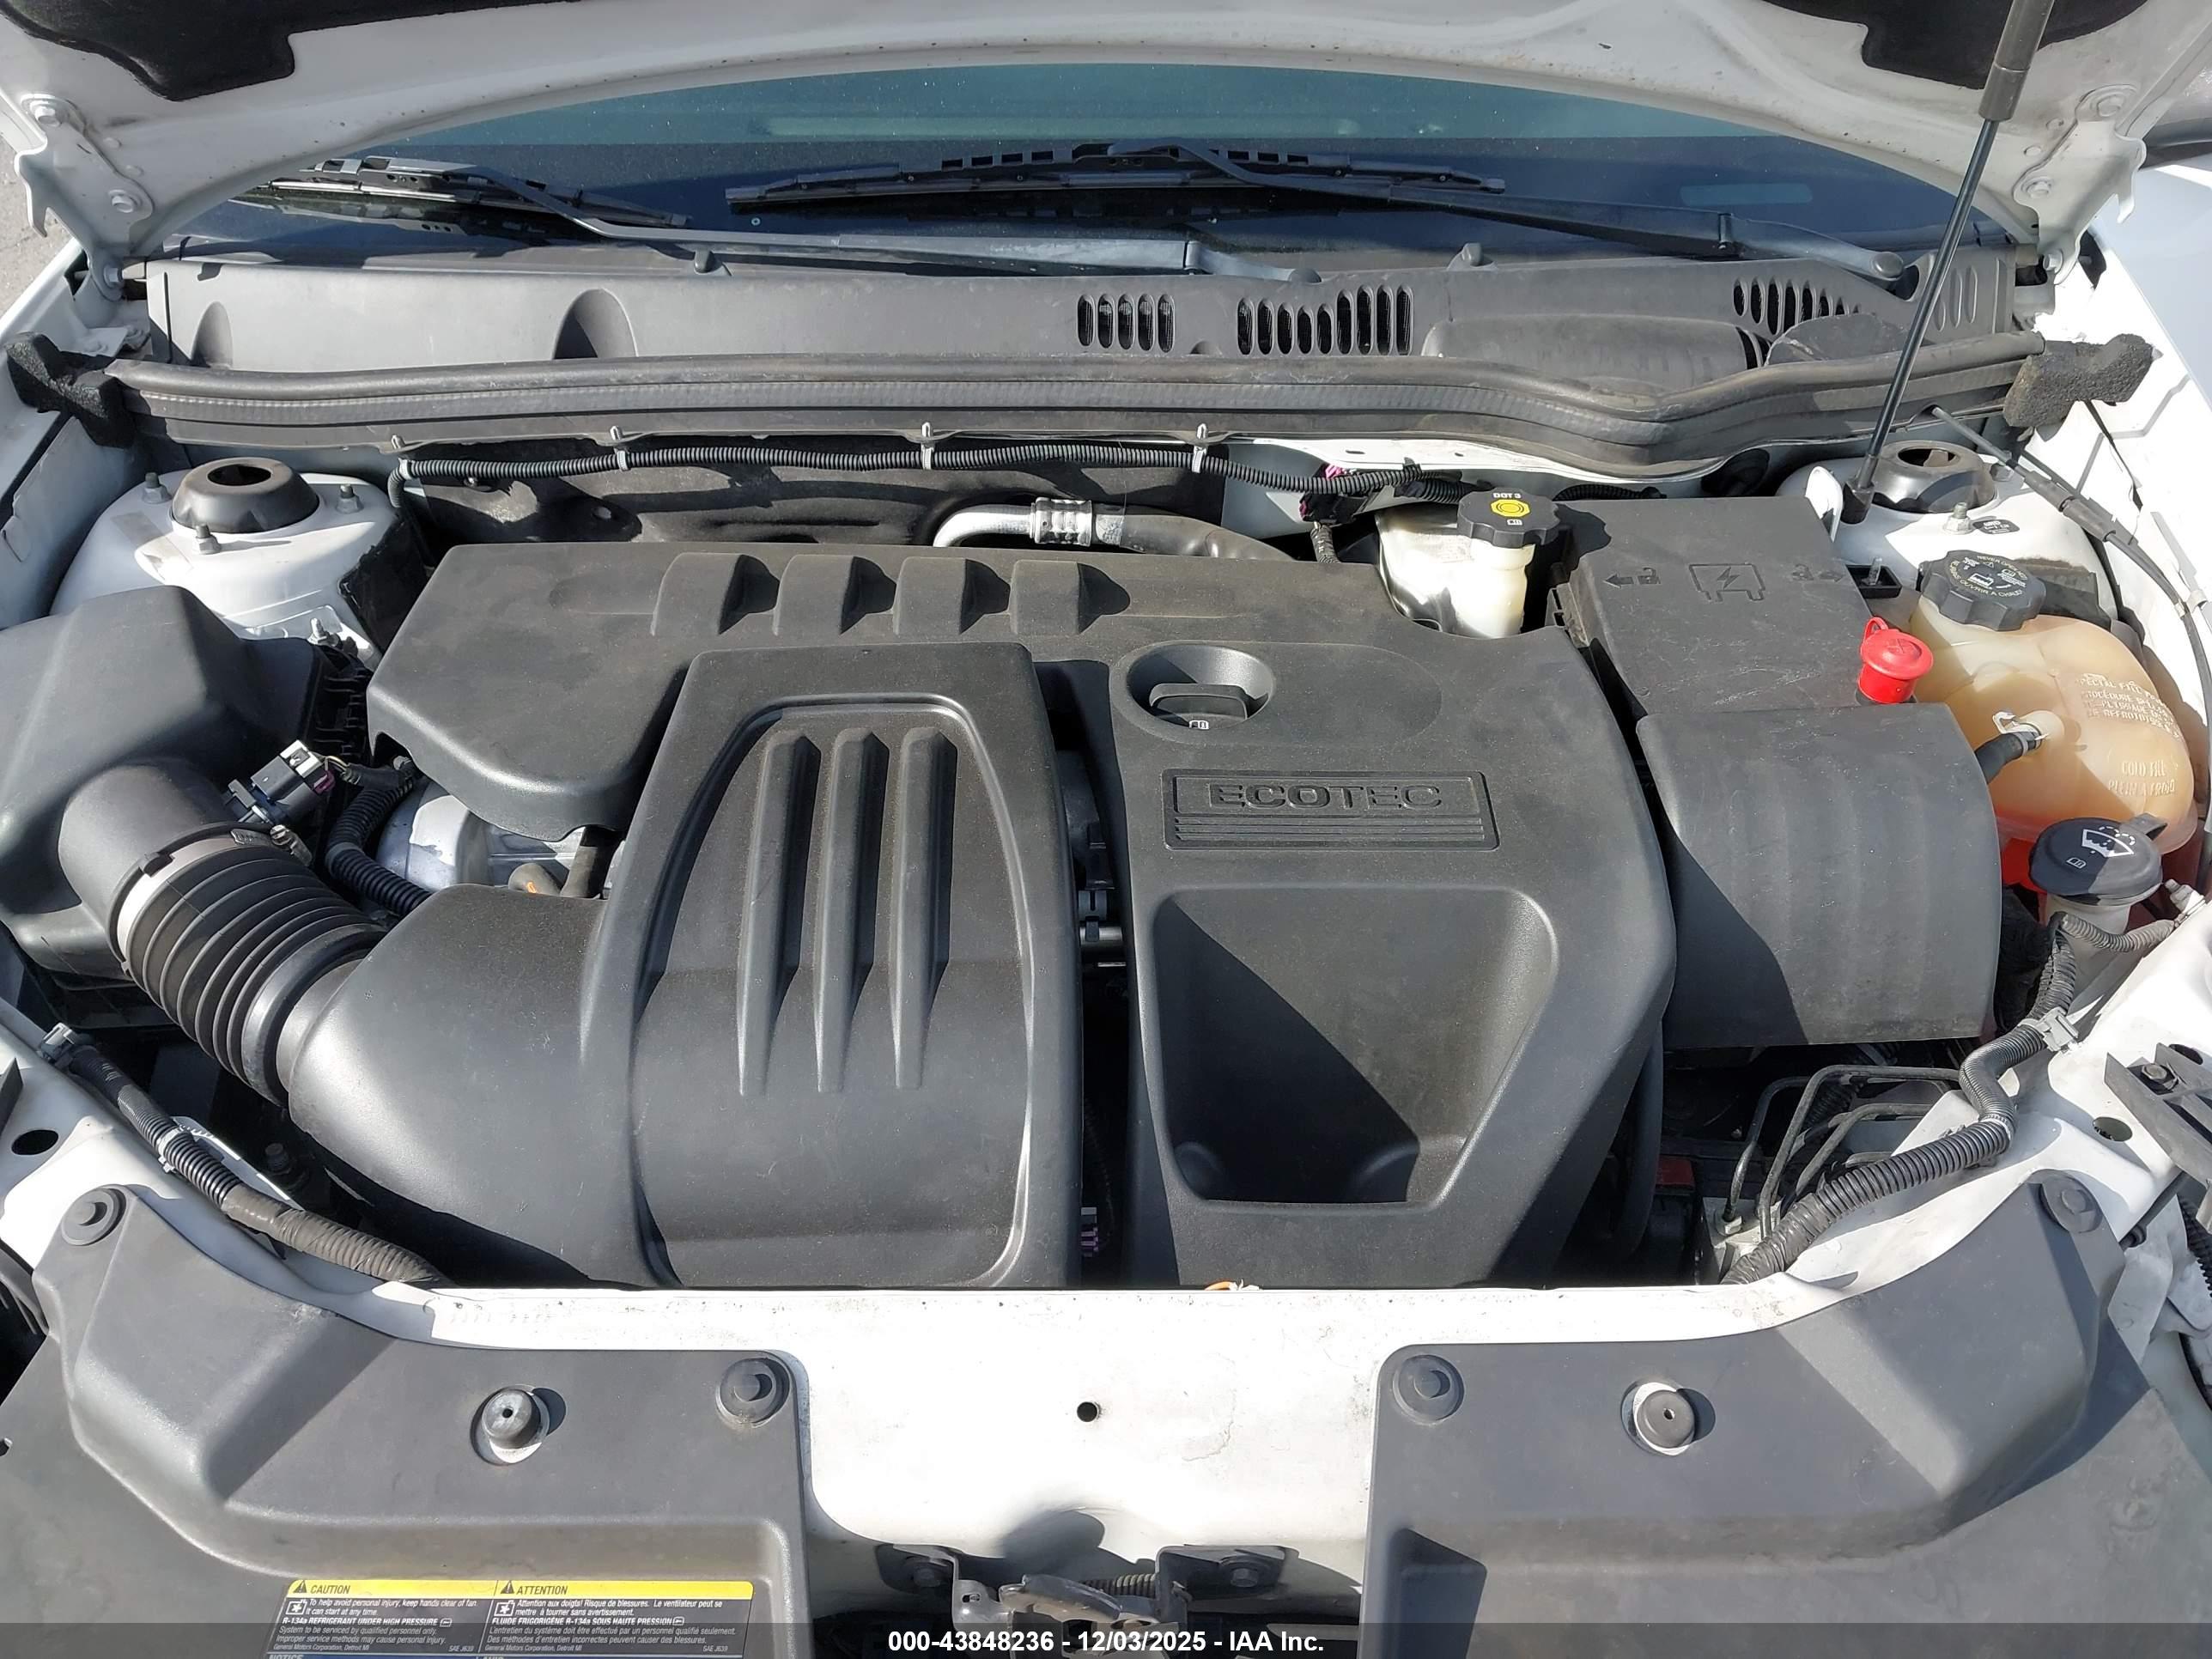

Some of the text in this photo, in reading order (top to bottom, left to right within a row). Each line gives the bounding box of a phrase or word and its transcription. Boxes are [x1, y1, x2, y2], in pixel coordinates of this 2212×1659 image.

[1208, 784, 1443, 809] ECOTEC
[310, 1584, 350, 1594] CAUTION
[516, 1585, 568, 1595] ATTENTION
[319, 1599, 332, 1607] help
[352, 1599, 380, 1607] personal
[561, 1600, 582, 1608] doigts!
[584, 1600, 606, 1608] Risque
[279, 1626, 303, 1634] System
[350, 1626, 358, 1635] by
[360, 1626, 387, 1635] qualified
[422, 1627, 437, 1636] only.
[641, 1627, 674, 1636] personnel
[675, 1627, 699, 1636] qualifié
